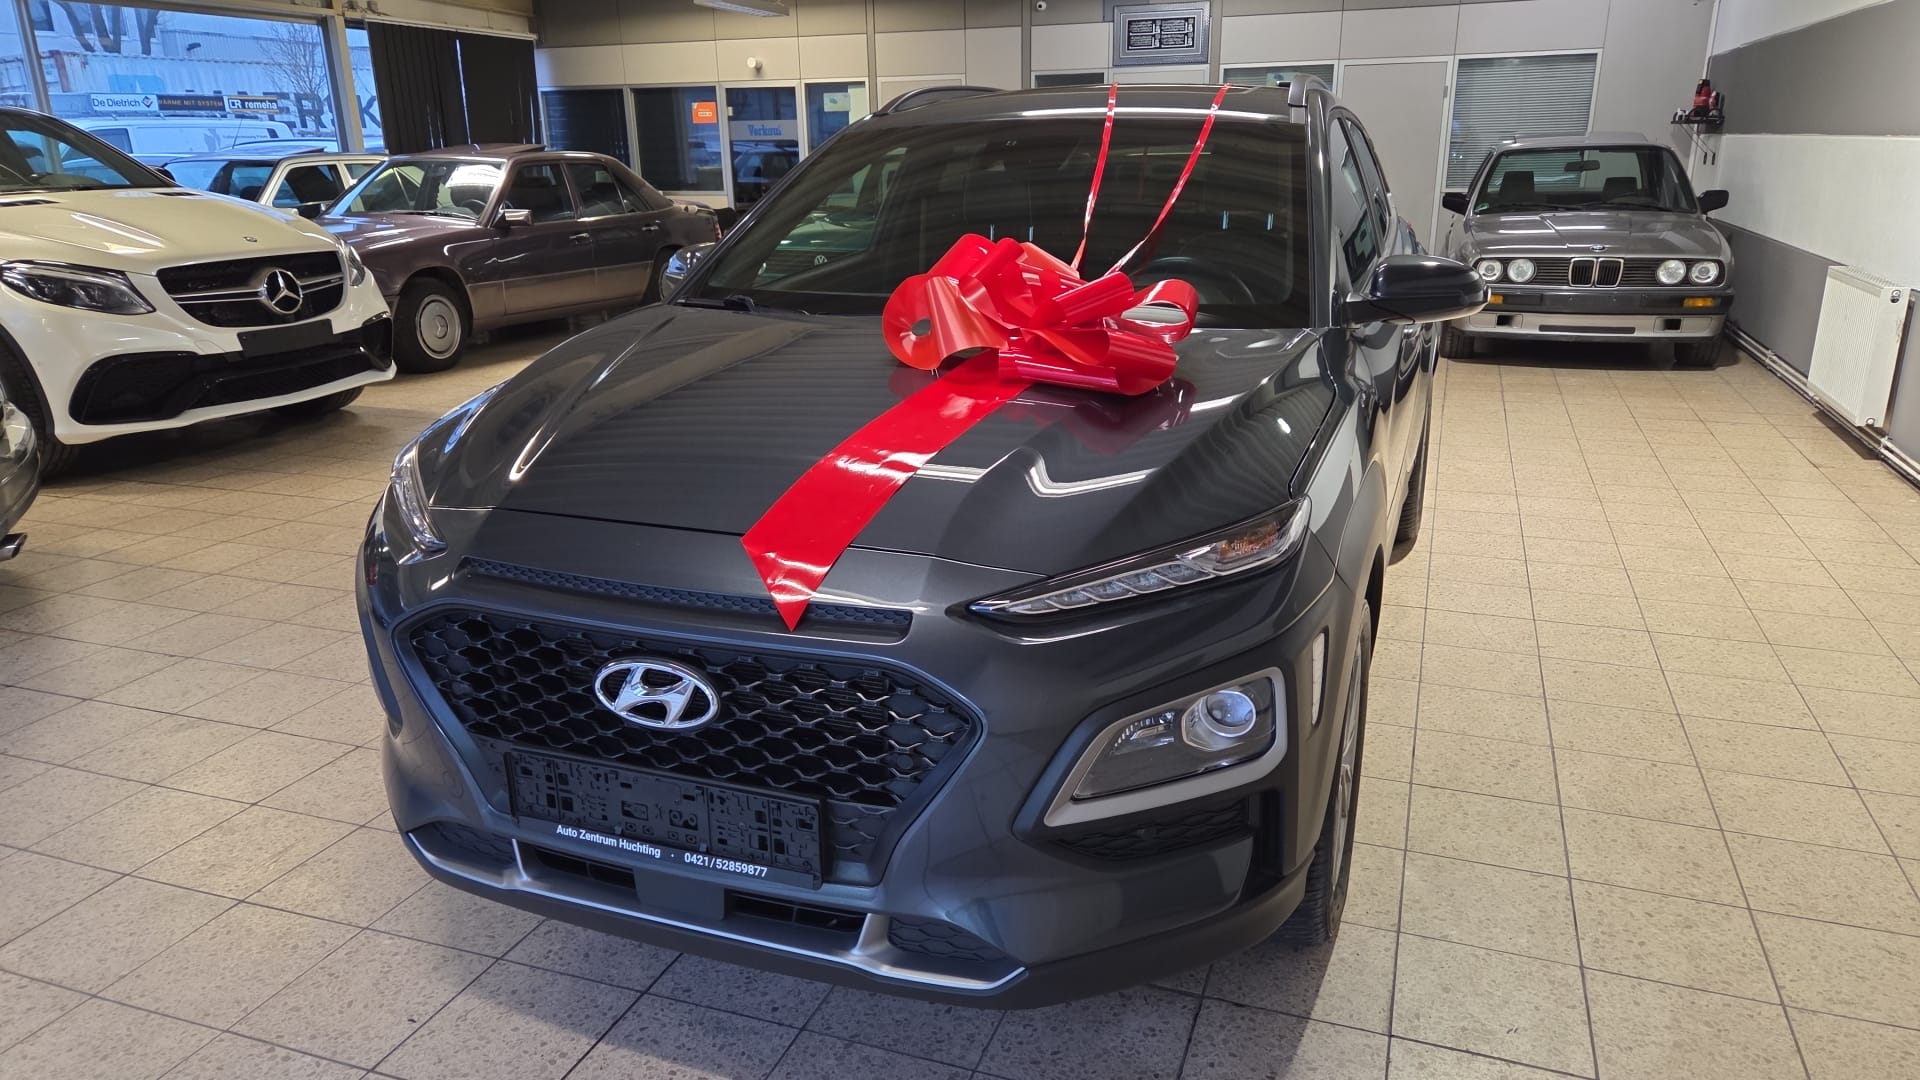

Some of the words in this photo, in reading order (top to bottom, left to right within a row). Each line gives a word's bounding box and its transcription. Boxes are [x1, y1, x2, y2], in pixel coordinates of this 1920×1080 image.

[92, 97, 106, 107] De
[107, 97, 141, 107] Dietrich
[244, 100, 277, 109] remeha
[556, 825, 577, 838] Auto
[579, 829, 617, 847] Zentrum
[619, 838, 661, 859] Huchting
[684, 852, 768, 878] 0421/52859877
